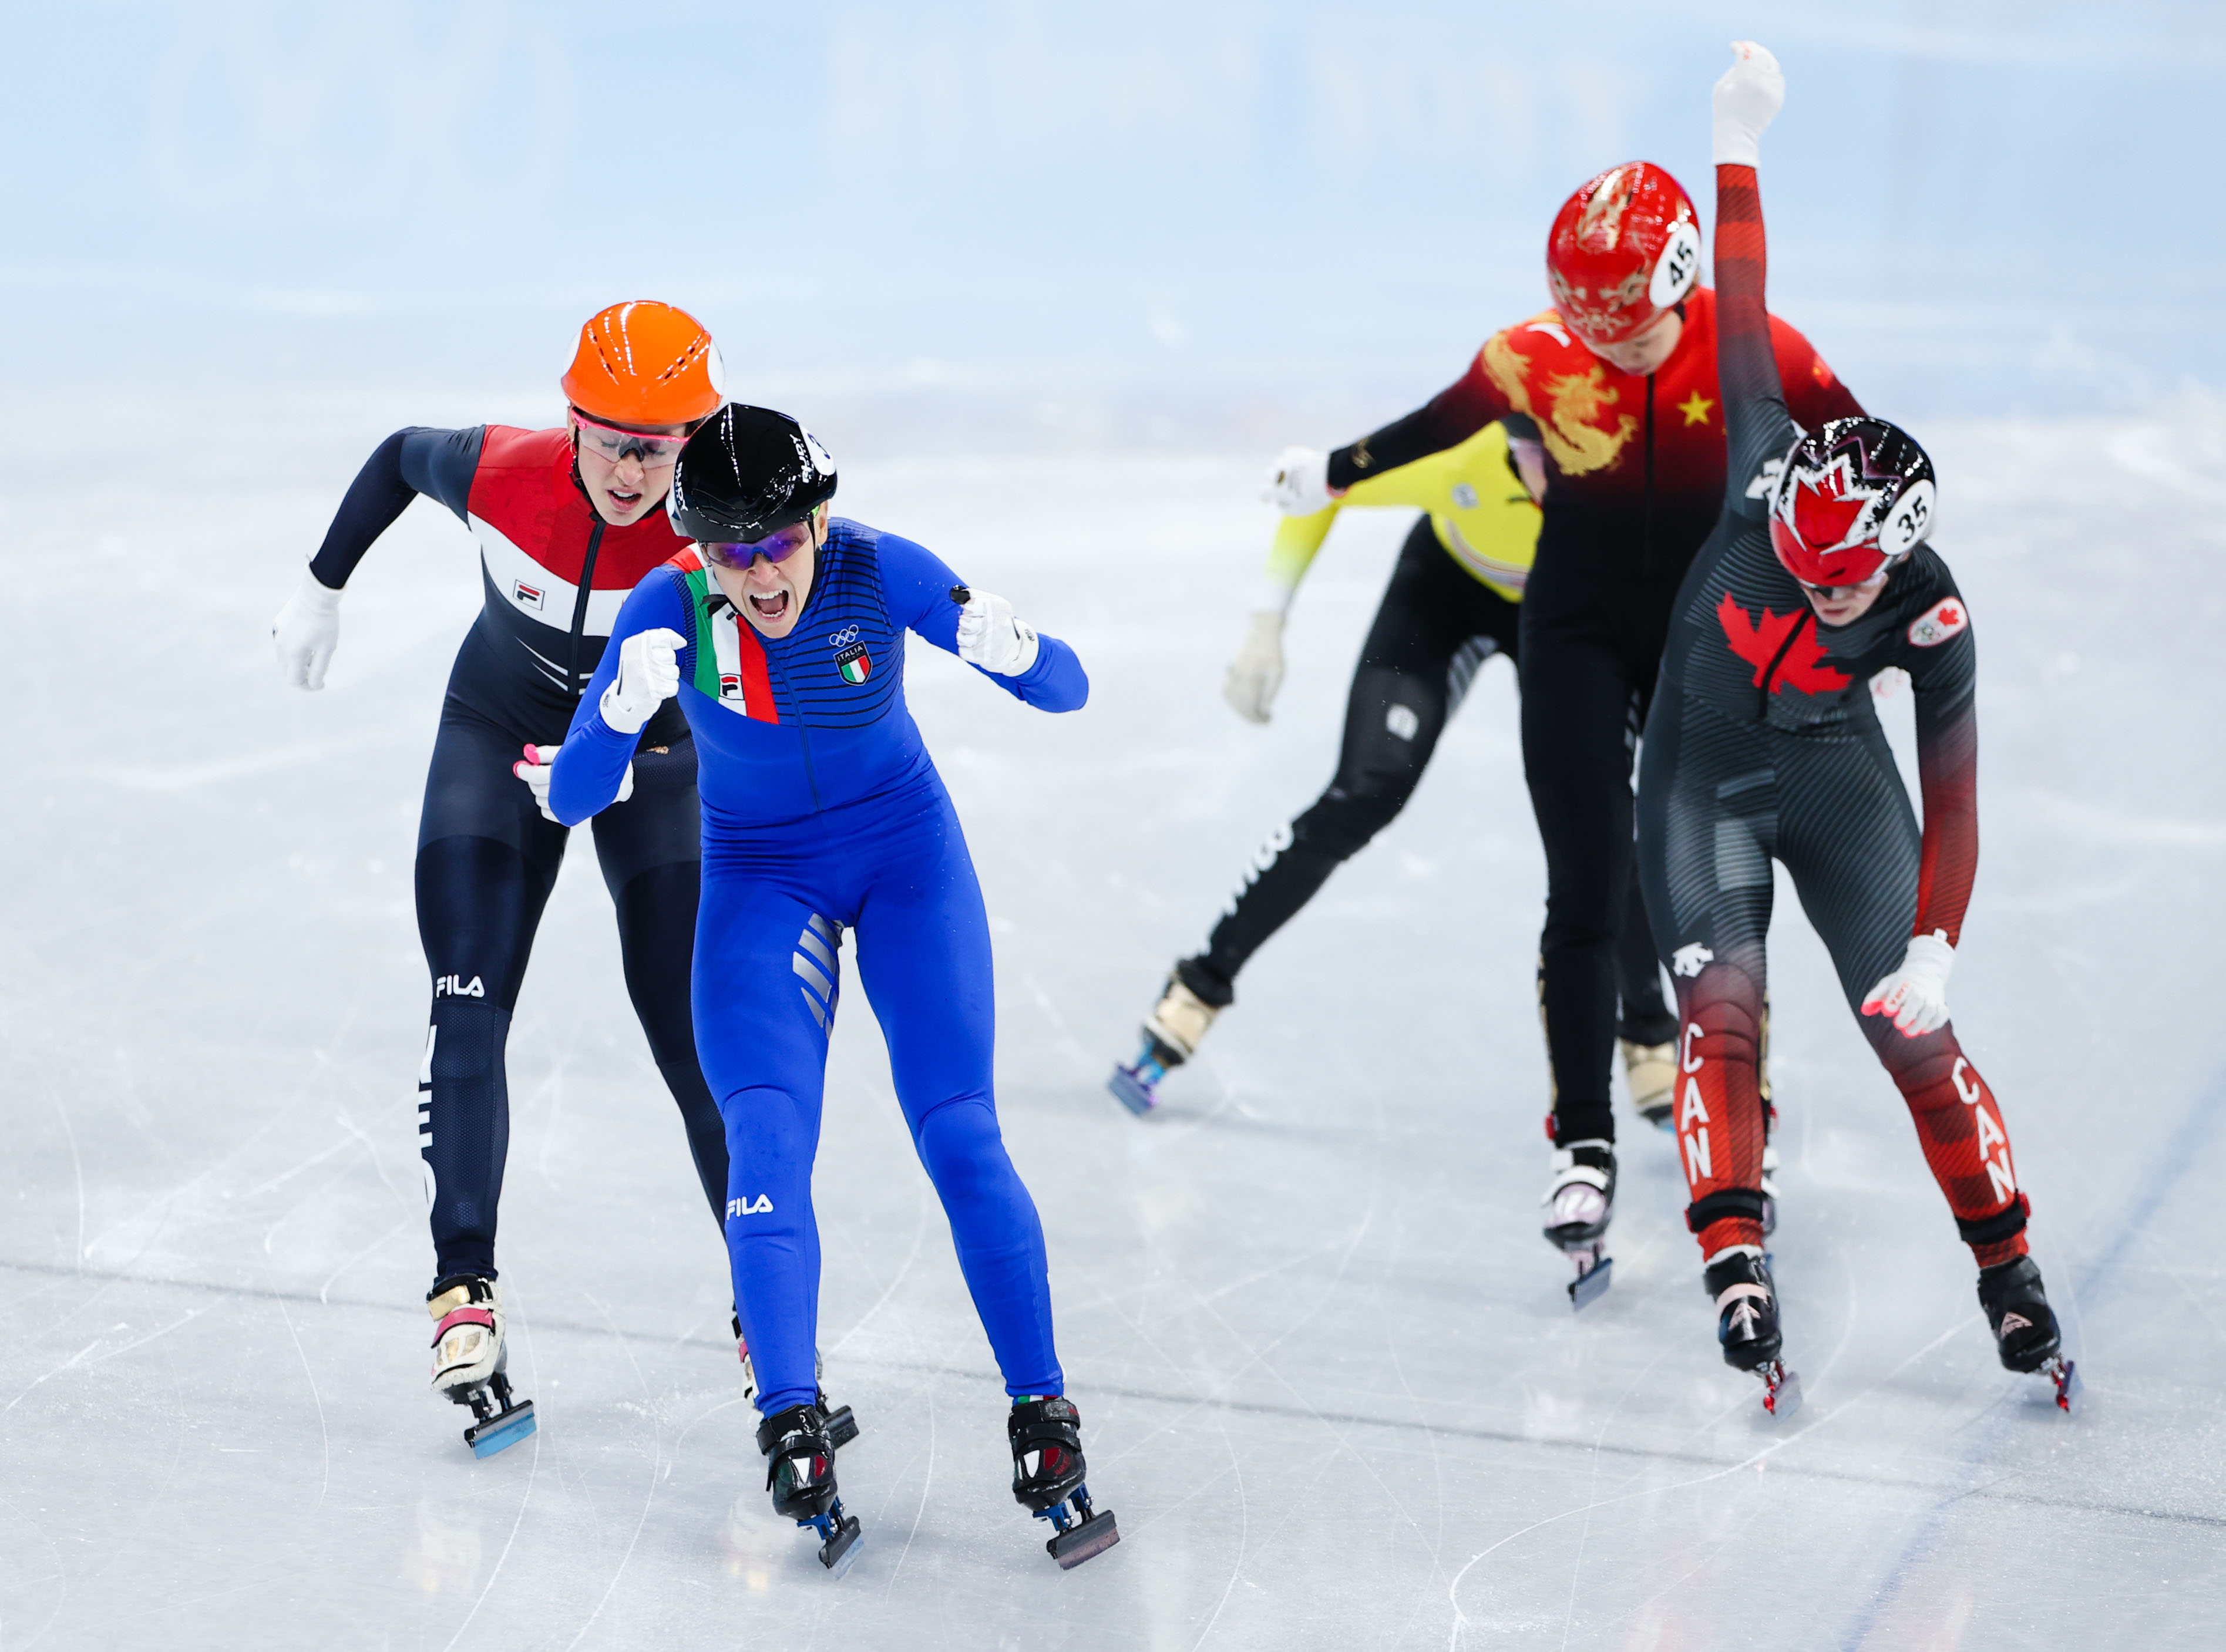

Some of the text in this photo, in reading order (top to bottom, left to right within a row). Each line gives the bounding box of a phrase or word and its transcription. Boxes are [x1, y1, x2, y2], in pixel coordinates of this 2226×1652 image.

[1670, 240, 1694, 287] 45
[1897, 495, 1927, 543] 35
[837, 645, 863, 662] ITALIA
[436, 974, 485, 998] FILA
[1680, 1022, 1713, 1187] CAN
[1951, 1056, 2016, 1205] CAN
[726, 1193, 775, 1221] FILA
